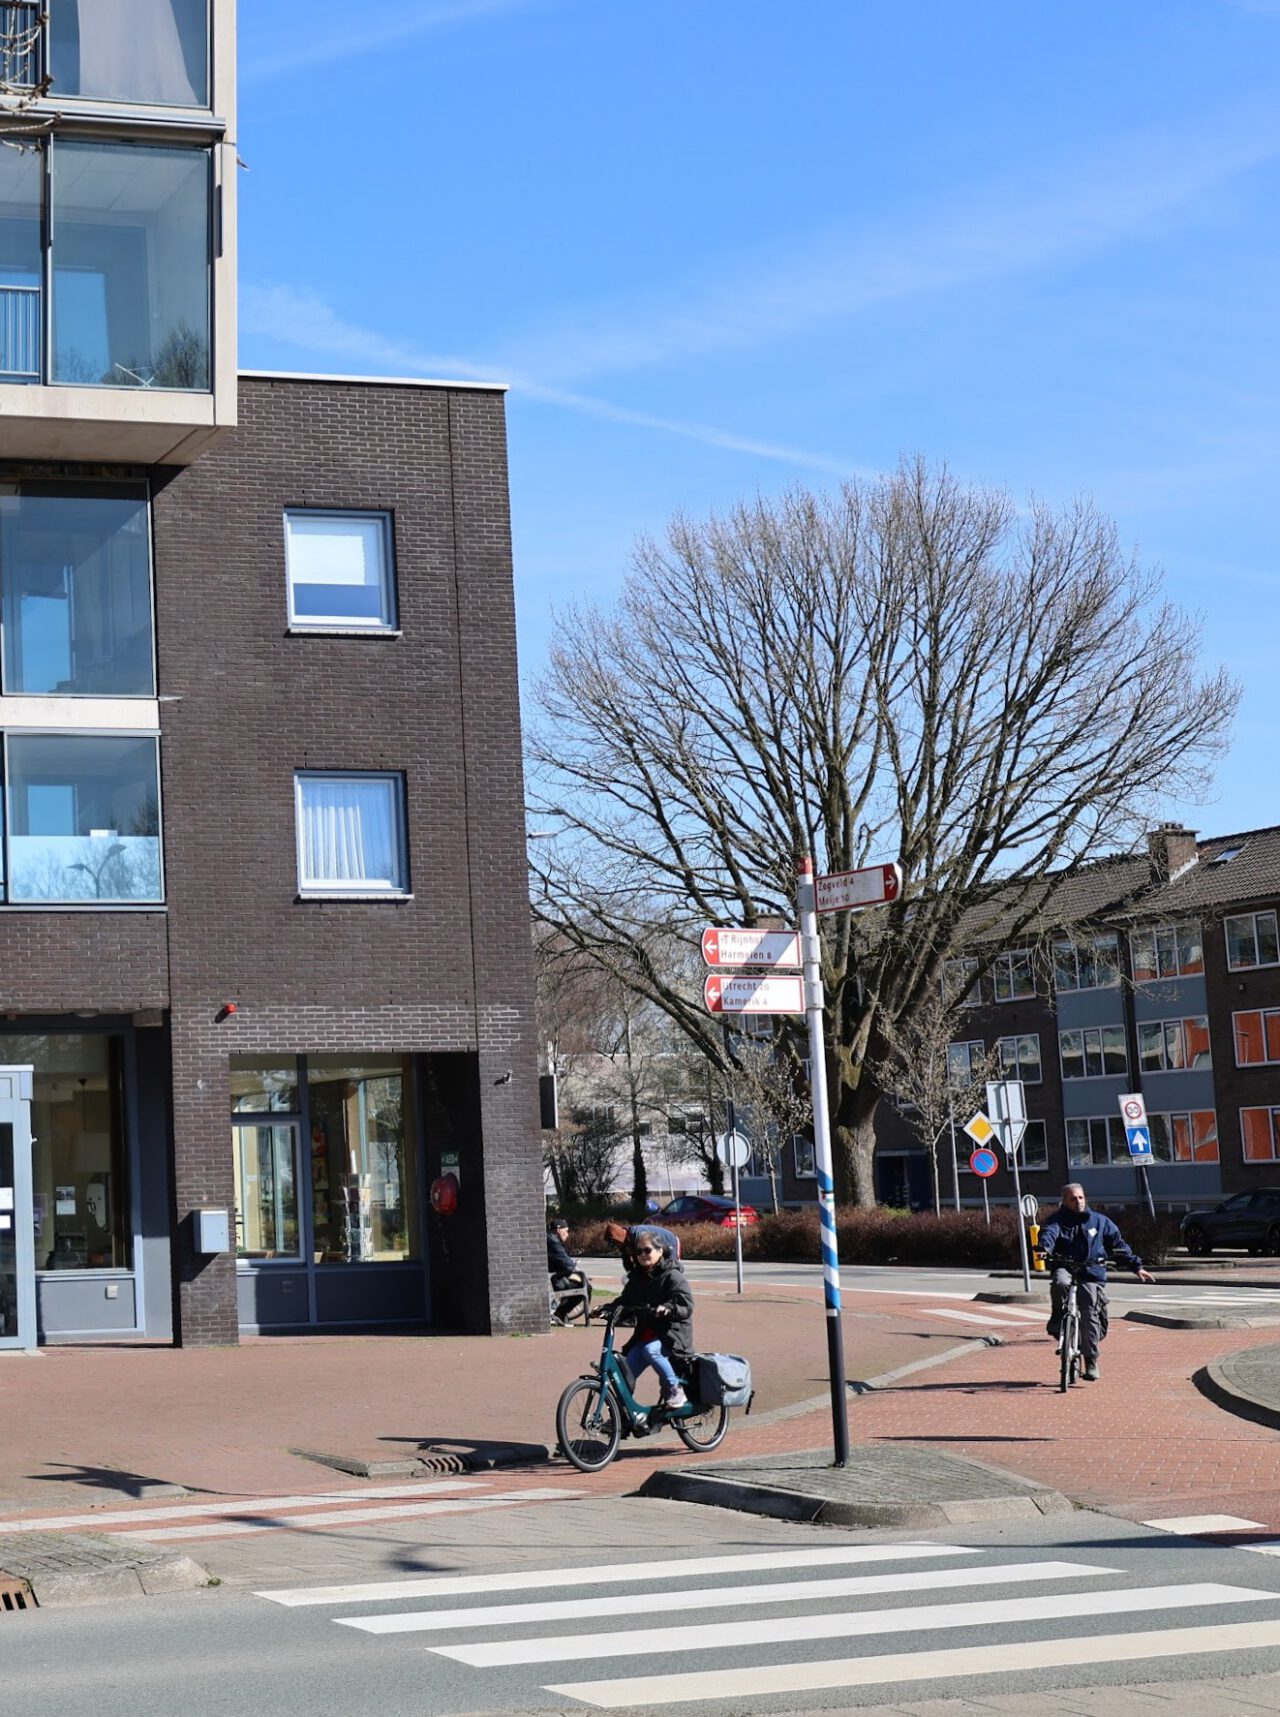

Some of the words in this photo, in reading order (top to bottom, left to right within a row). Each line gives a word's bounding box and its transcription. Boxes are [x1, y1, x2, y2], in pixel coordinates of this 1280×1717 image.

[818, 878, 847, 892] Zegveld
[721, 950, 764, 960] Harmelen
[723, 981, 756, 991] Utrecht
[1128, 1106, 1138, 1114] 30
